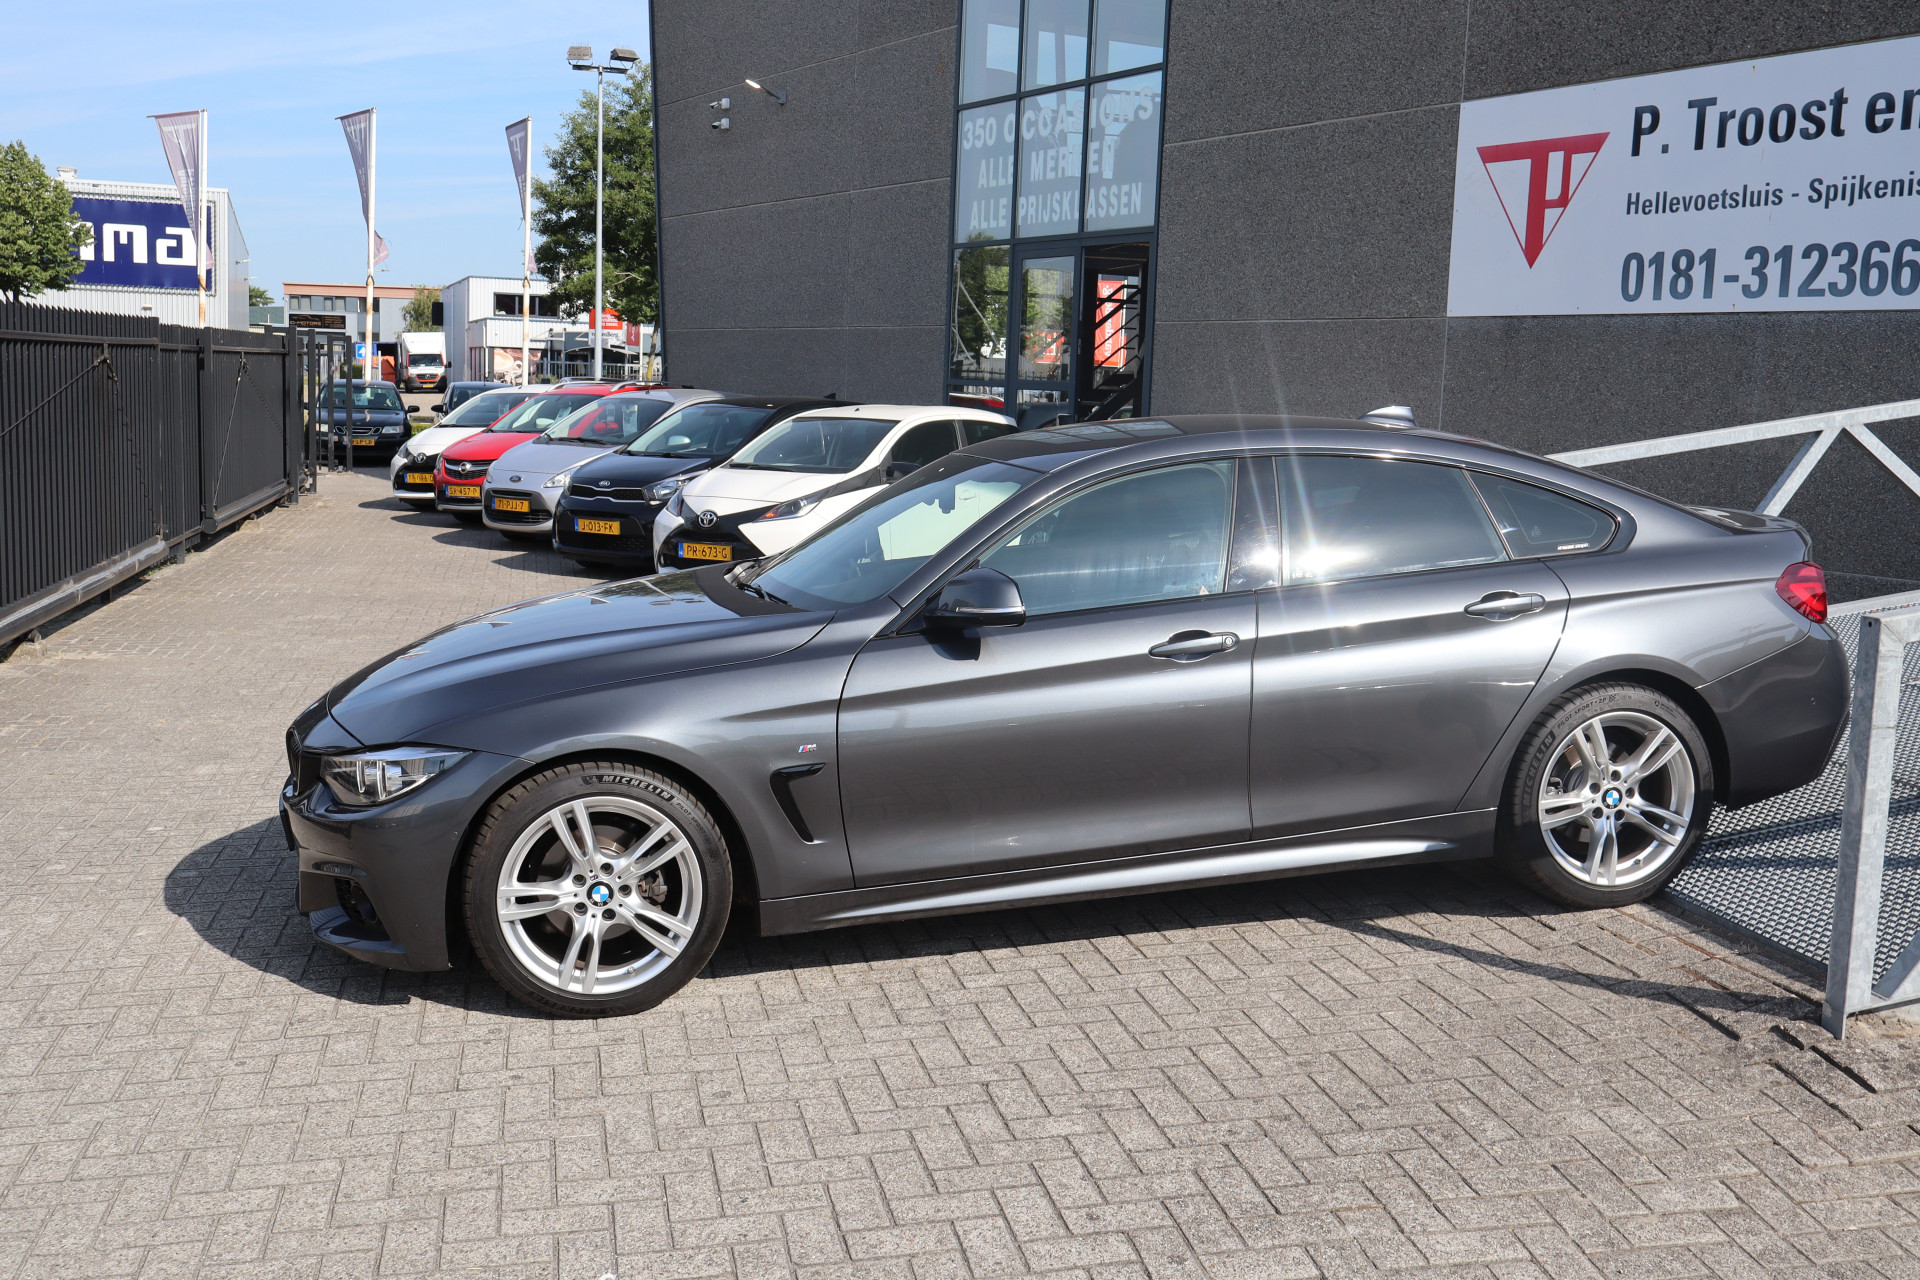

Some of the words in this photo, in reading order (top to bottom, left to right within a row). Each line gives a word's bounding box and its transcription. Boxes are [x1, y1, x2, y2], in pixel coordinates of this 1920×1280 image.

[962, 116, 997, 150] 350
[1003, 86, 1154, 144] OCCASIONS
[1630, 104, 1670, 157] P.
[1687, 86, 1849, 151] Troost
[1865, 88, 1920, 134] en
[978, 155, 1014, 189] ALLE
[969, 197, 1008, 230] ALLE
[1017, 181, 1143, 226] PRIJSKLASSEN
[1626, 183, 1784, 216] Hellevoetsluis
[1620, 238, 1920, 302] 0181-312366
[581, 520, 615, 533] J-013-FK
[686, 544, 728, 559] PR-673-G
[602, 775, 671, 800] MICHELIN
[676, 802, 692, 816] PILOT
